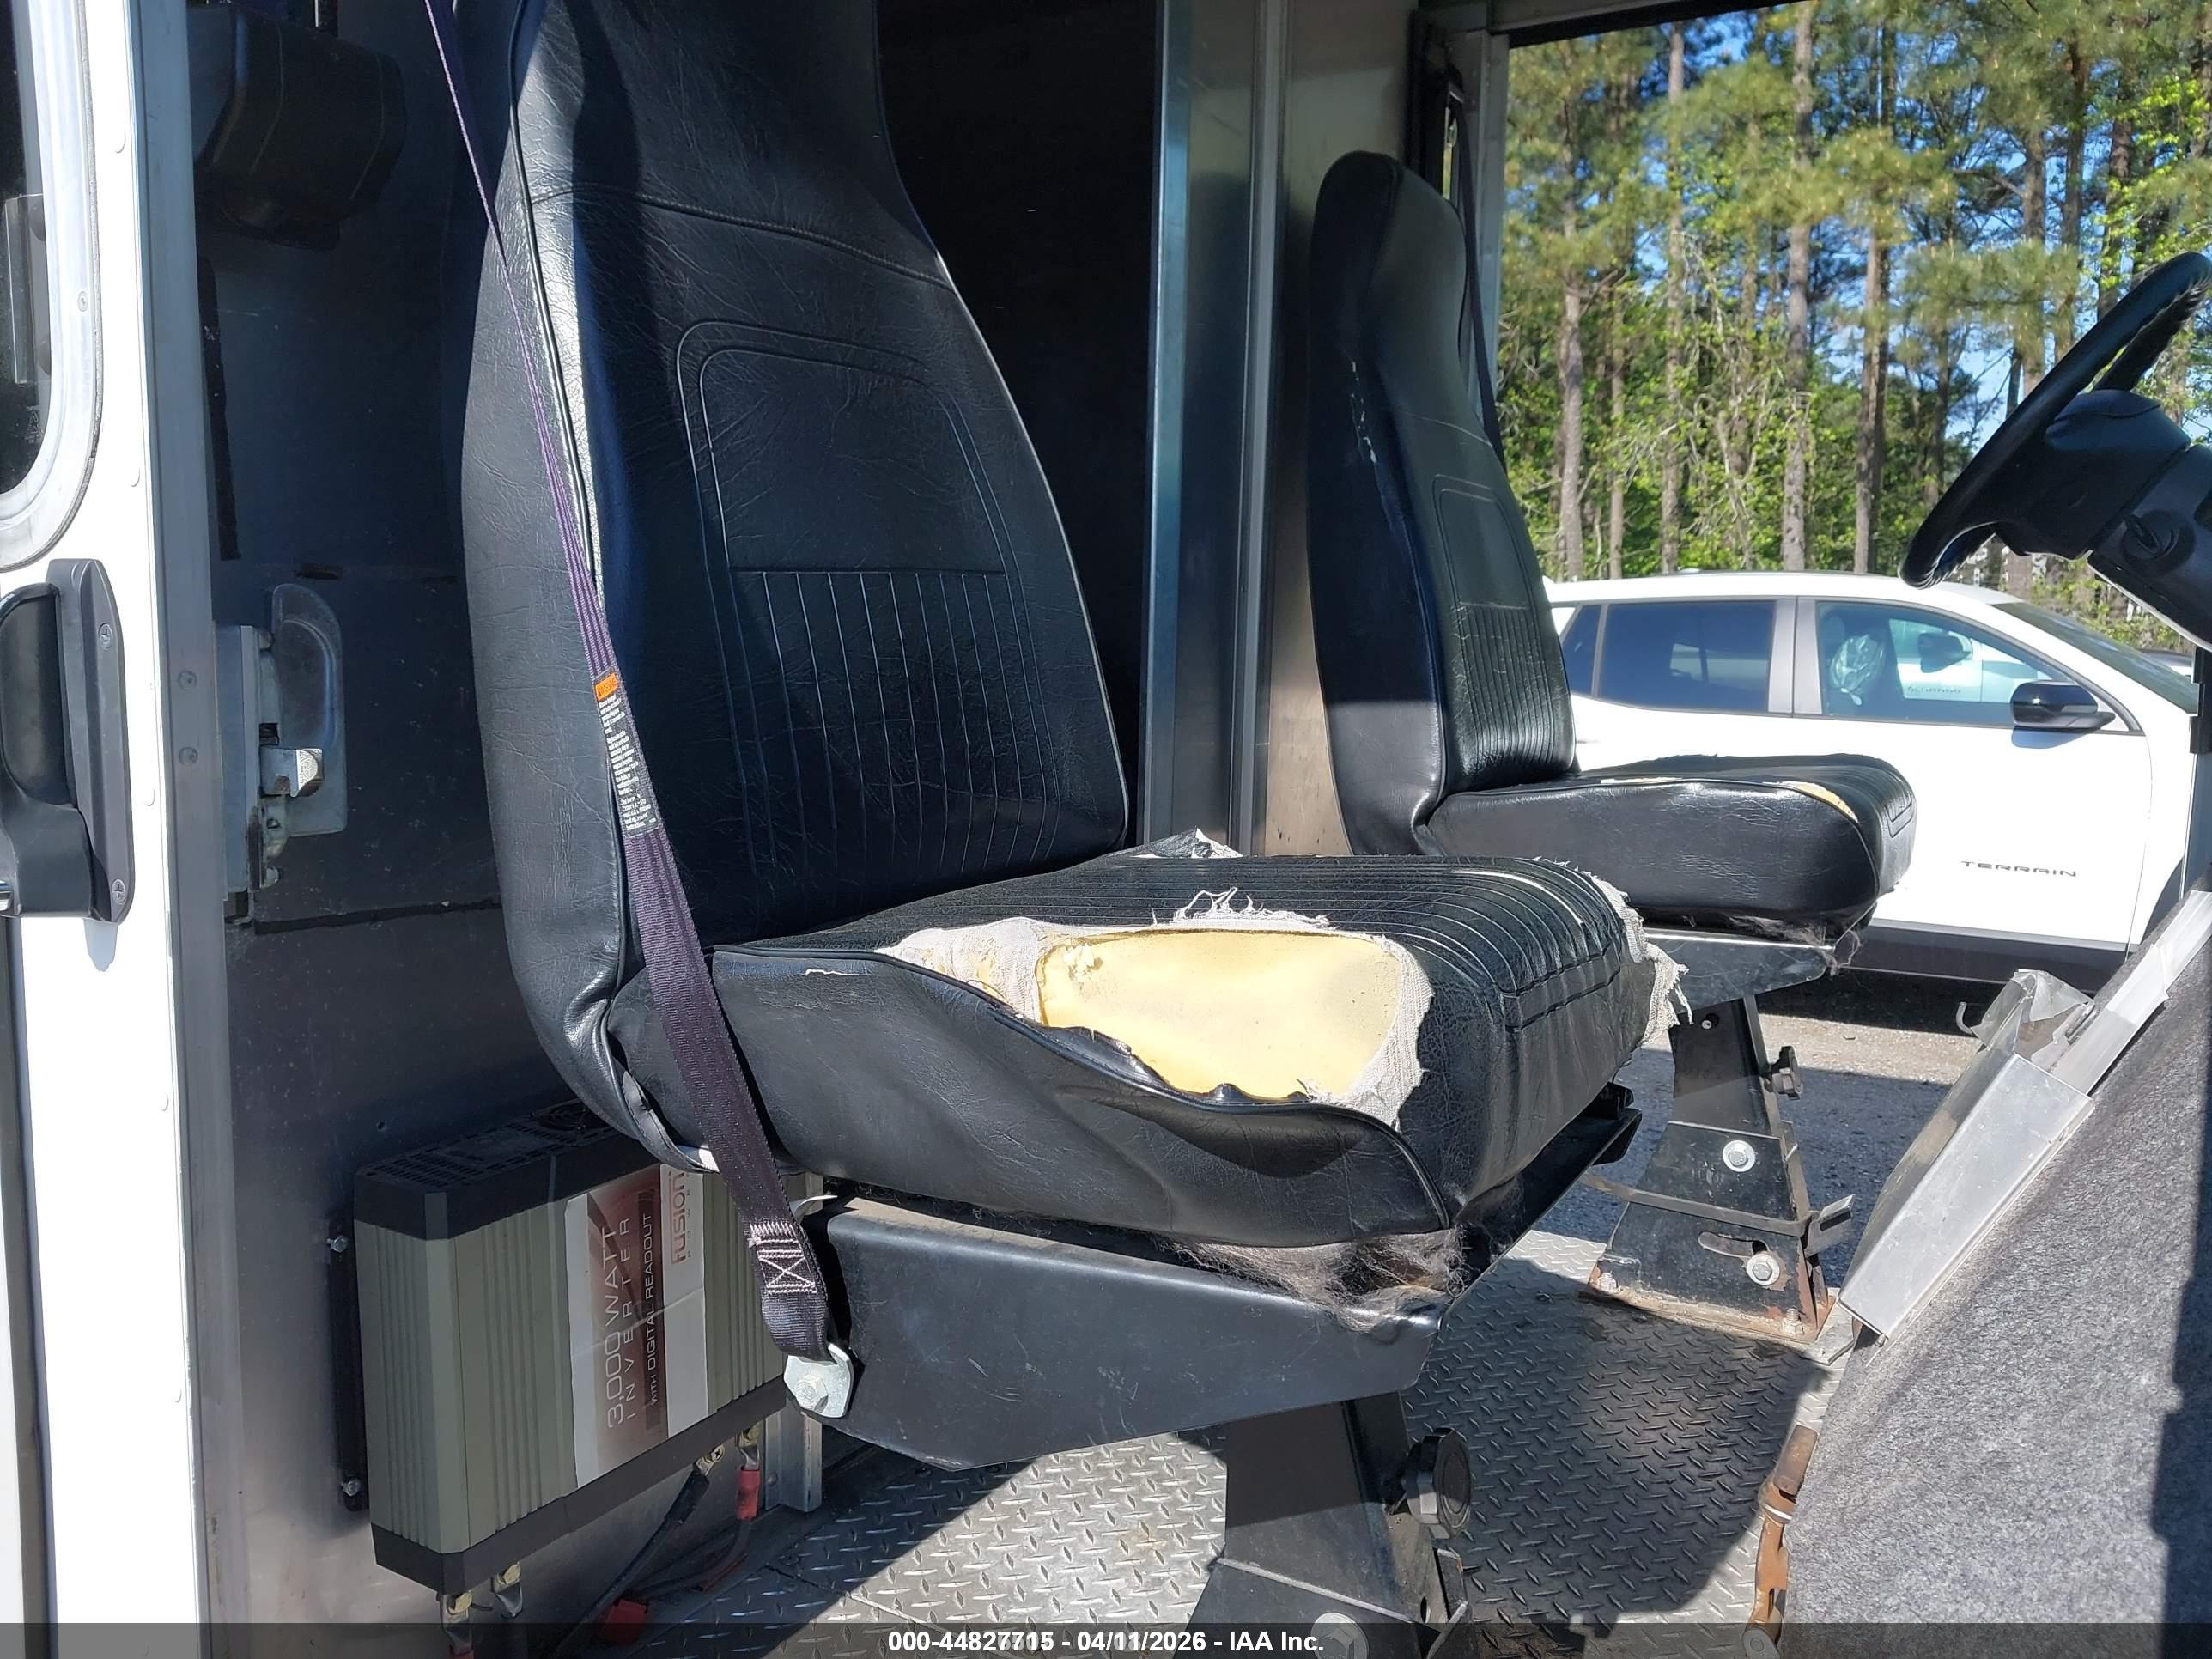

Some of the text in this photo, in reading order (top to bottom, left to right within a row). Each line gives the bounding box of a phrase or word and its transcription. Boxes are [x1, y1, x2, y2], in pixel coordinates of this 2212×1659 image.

[1960, 861, 2076, 877] TERRAIN
[643, 1214, 653, 1299] READOUT
[602, 1225, 624, 1428] 3,000 WATT
[620, 1218, 636, 1419] INVERTER
[646, 1304, 657, 1371] DIGITAL
